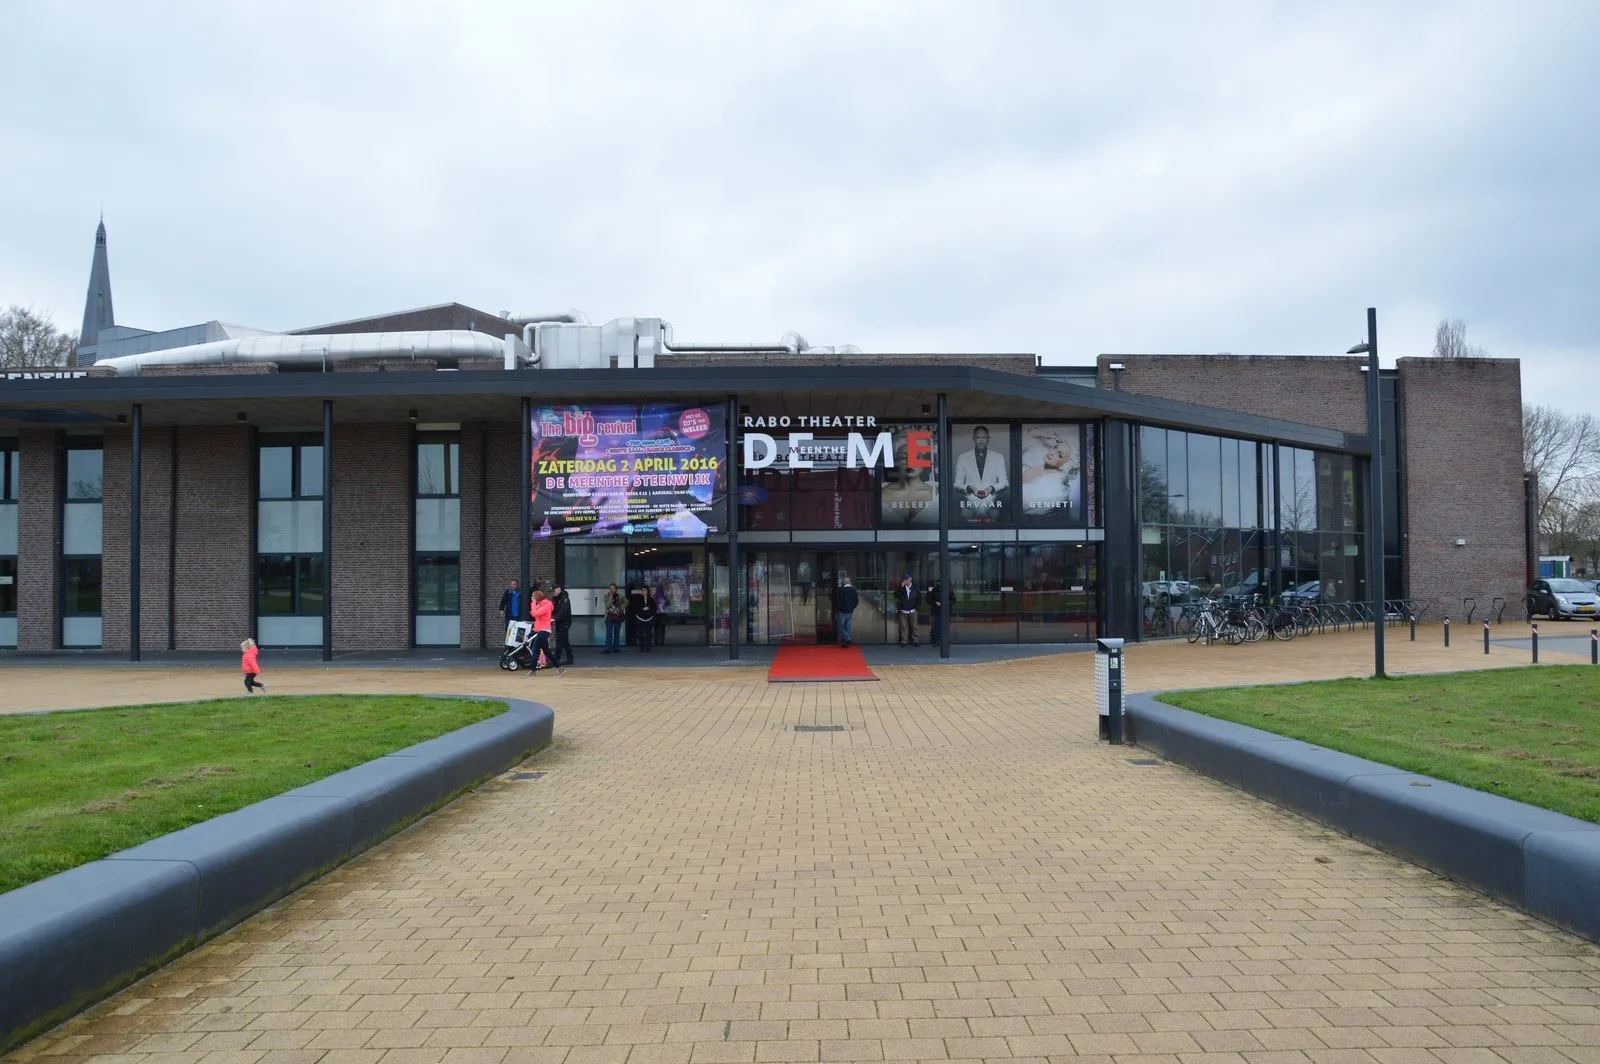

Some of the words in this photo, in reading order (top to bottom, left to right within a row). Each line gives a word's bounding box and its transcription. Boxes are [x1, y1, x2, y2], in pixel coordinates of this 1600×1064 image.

[541, 422, 562, 437] The
[564, 411, 598, 447] big
[597, 420, 637, 436] revival
[682, 418, 697, 426] DJ'S
[682, 424, 708, 433] WELEER
[744, 416, 791, 428] RABO
[798, 416, 877, 428] THEATER
[744, 432, 813, 468] DE
[846, 431, 933, 468] ME
[538, 459, 616, 474] ZATERDAG
[620, 460, 629, 472] 2
[634, 458, 677, 472] APRIL
[681, 456, 718, 470] 2016
[546, 477, 564, 489] DE
[568, 476, 629, 488] MEENTHE
[633, 473, 711, 487] STEENWIJK
